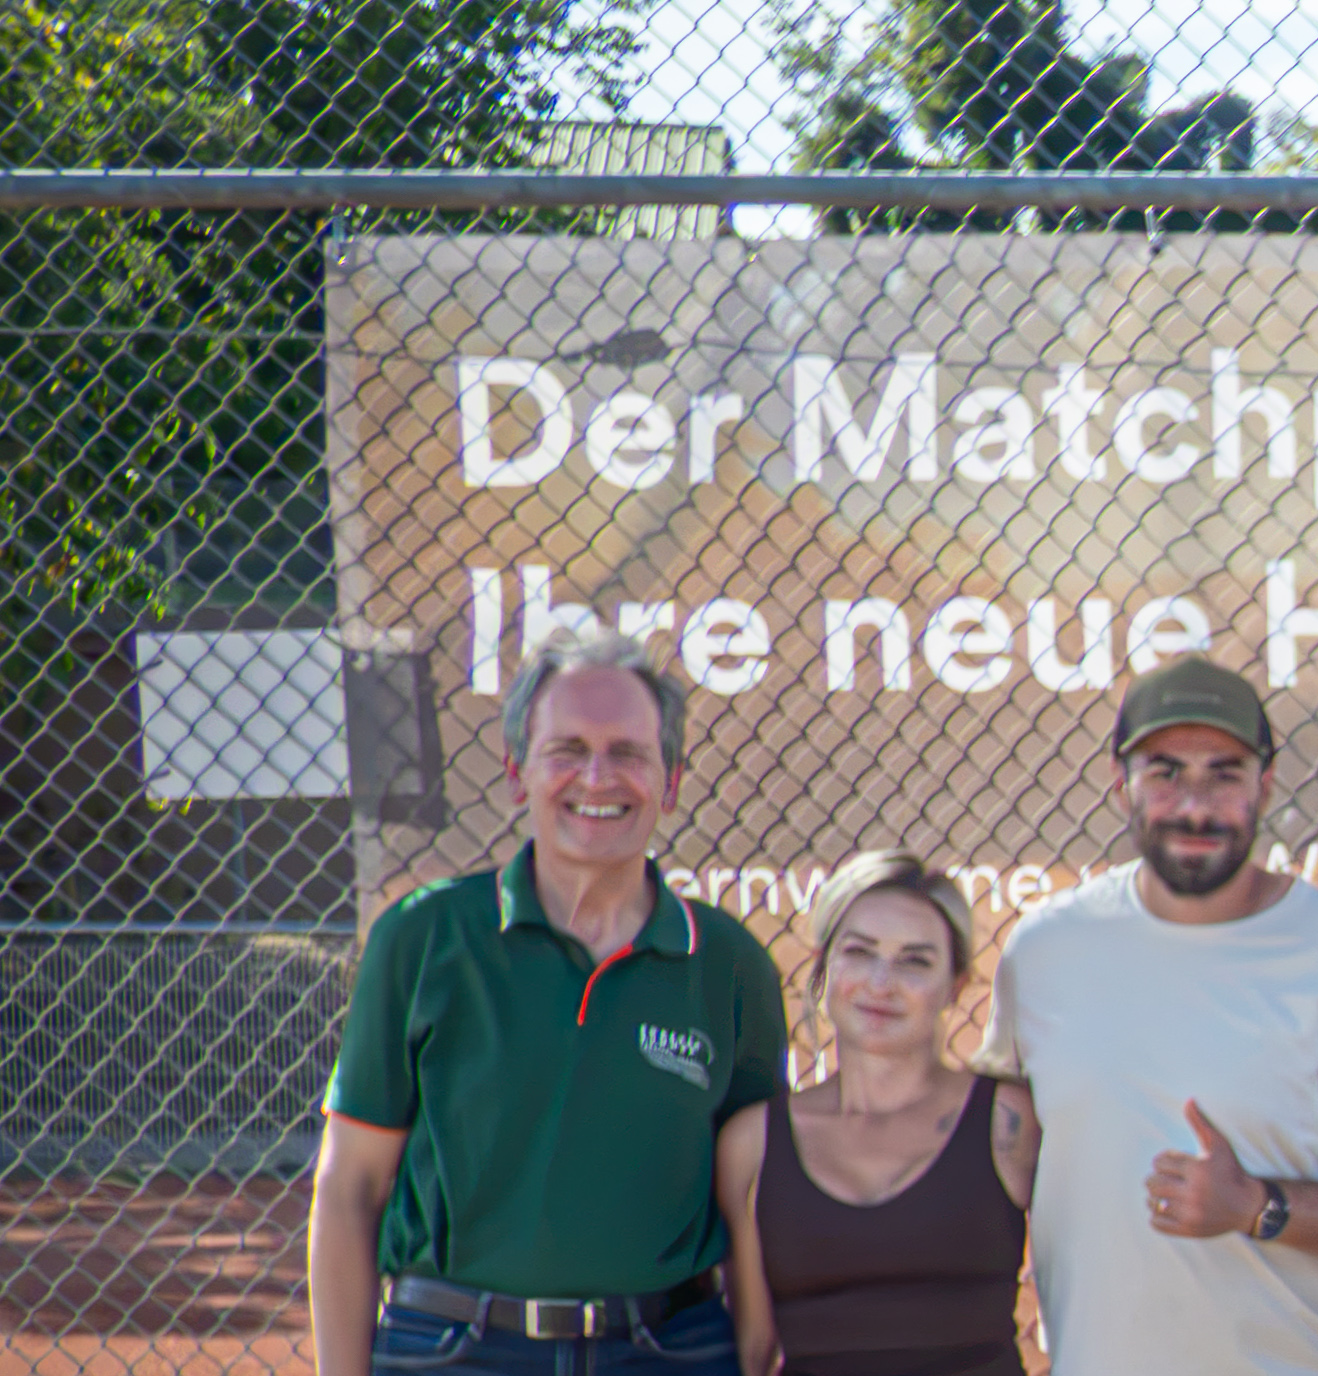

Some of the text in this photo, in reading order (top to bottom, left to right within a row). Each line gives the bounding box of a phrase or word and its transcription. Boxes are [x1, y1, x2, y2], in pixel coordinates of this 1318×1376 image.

[458, 355, 743, 489] Der
[471, 565, 771, 695] Ihre
[825, 595, 1210, 694] neue
